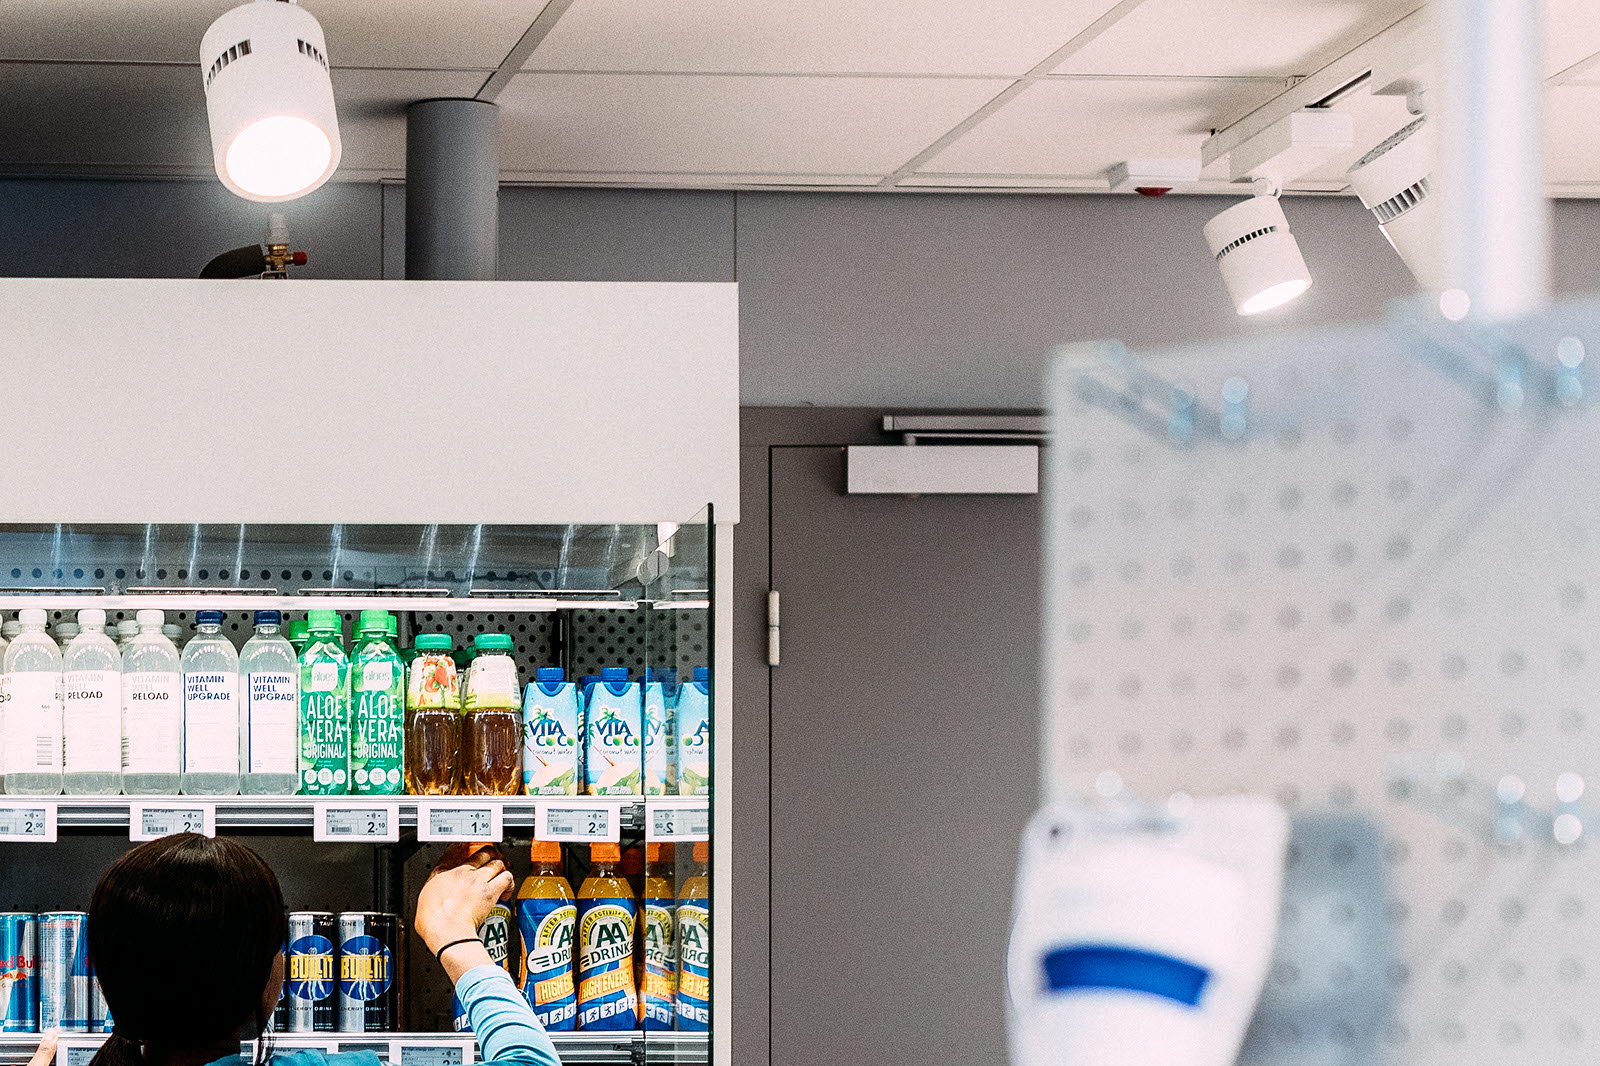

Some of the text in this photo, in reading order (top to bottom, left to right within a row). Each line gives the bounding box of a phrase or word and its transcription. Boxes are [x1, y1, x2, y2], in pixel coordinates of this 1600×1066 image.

[187, 675, 225, 684] VITAMIN
[253, 676, 290, 684] VITAMIN
[313, 670, 336, 682] aloes
[365, 669, 390, 681] aloes
[187, 684, 209, 692] WELL
[253, 685, 277, 693] WELL
[68, 691, 103, 700] RELOAD
[132, 692, 169, 700] RELOAD
[187, 692, 231, 701] UPGRADE
[306, 695, 343, 719] ALOE
[357, 695, 398, 719] ALOE
[307, 719, 343, 743] VERA
[357, 719, 398, 742] VERA
[528, 719, 565, 736] VITA
[595, 719, 632, 736] VITA
[306, 743, 344, 759] ORIGINAL
[357, 743, 398, 759] ORIGINAL
[25, 821, 43, 833] 2.00
[367, 821, 386, 834] 2.10
[588, 821, 606, 834] 2.00
[596, 921, 627, 948] AA
[587, 943, 631, 966] DRINK
